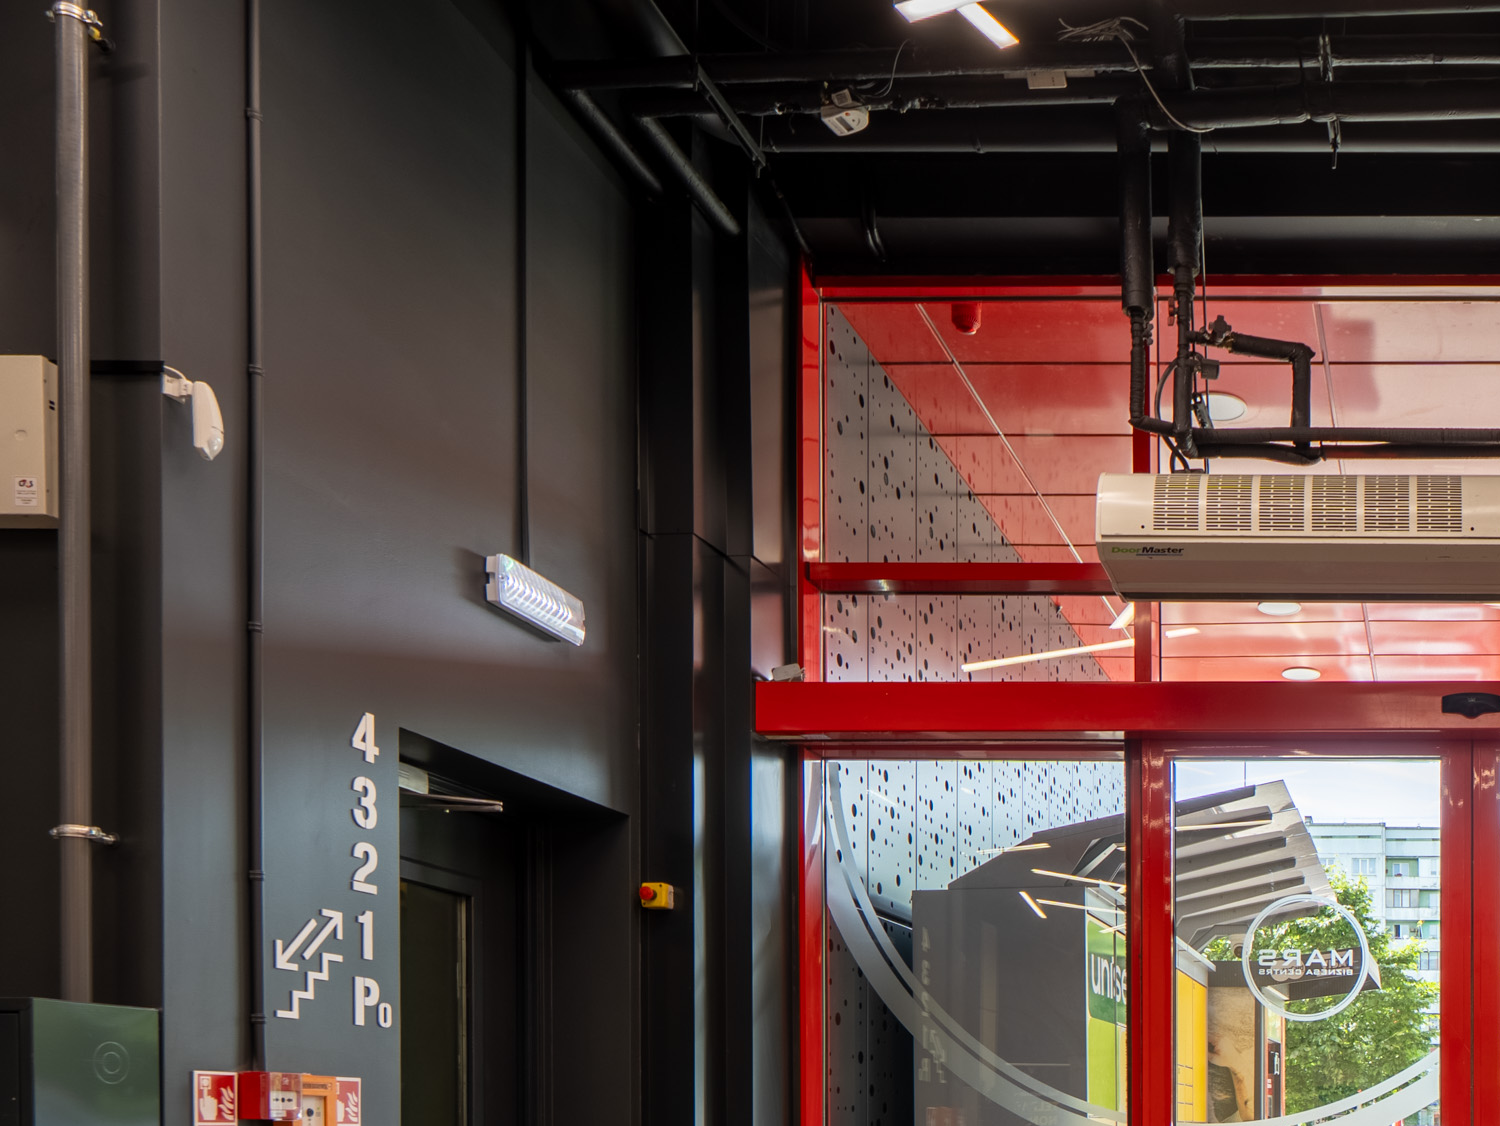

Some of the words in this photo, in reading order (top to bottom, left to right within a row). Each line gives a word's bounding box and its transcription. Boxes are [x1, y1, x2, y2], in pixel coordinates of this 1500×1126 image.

[351, 712, 379, 764] 4
[351, 776, 377, 829] 3
[351, 842, 378, 895] 2
[356, 910, 374, 960] 1
